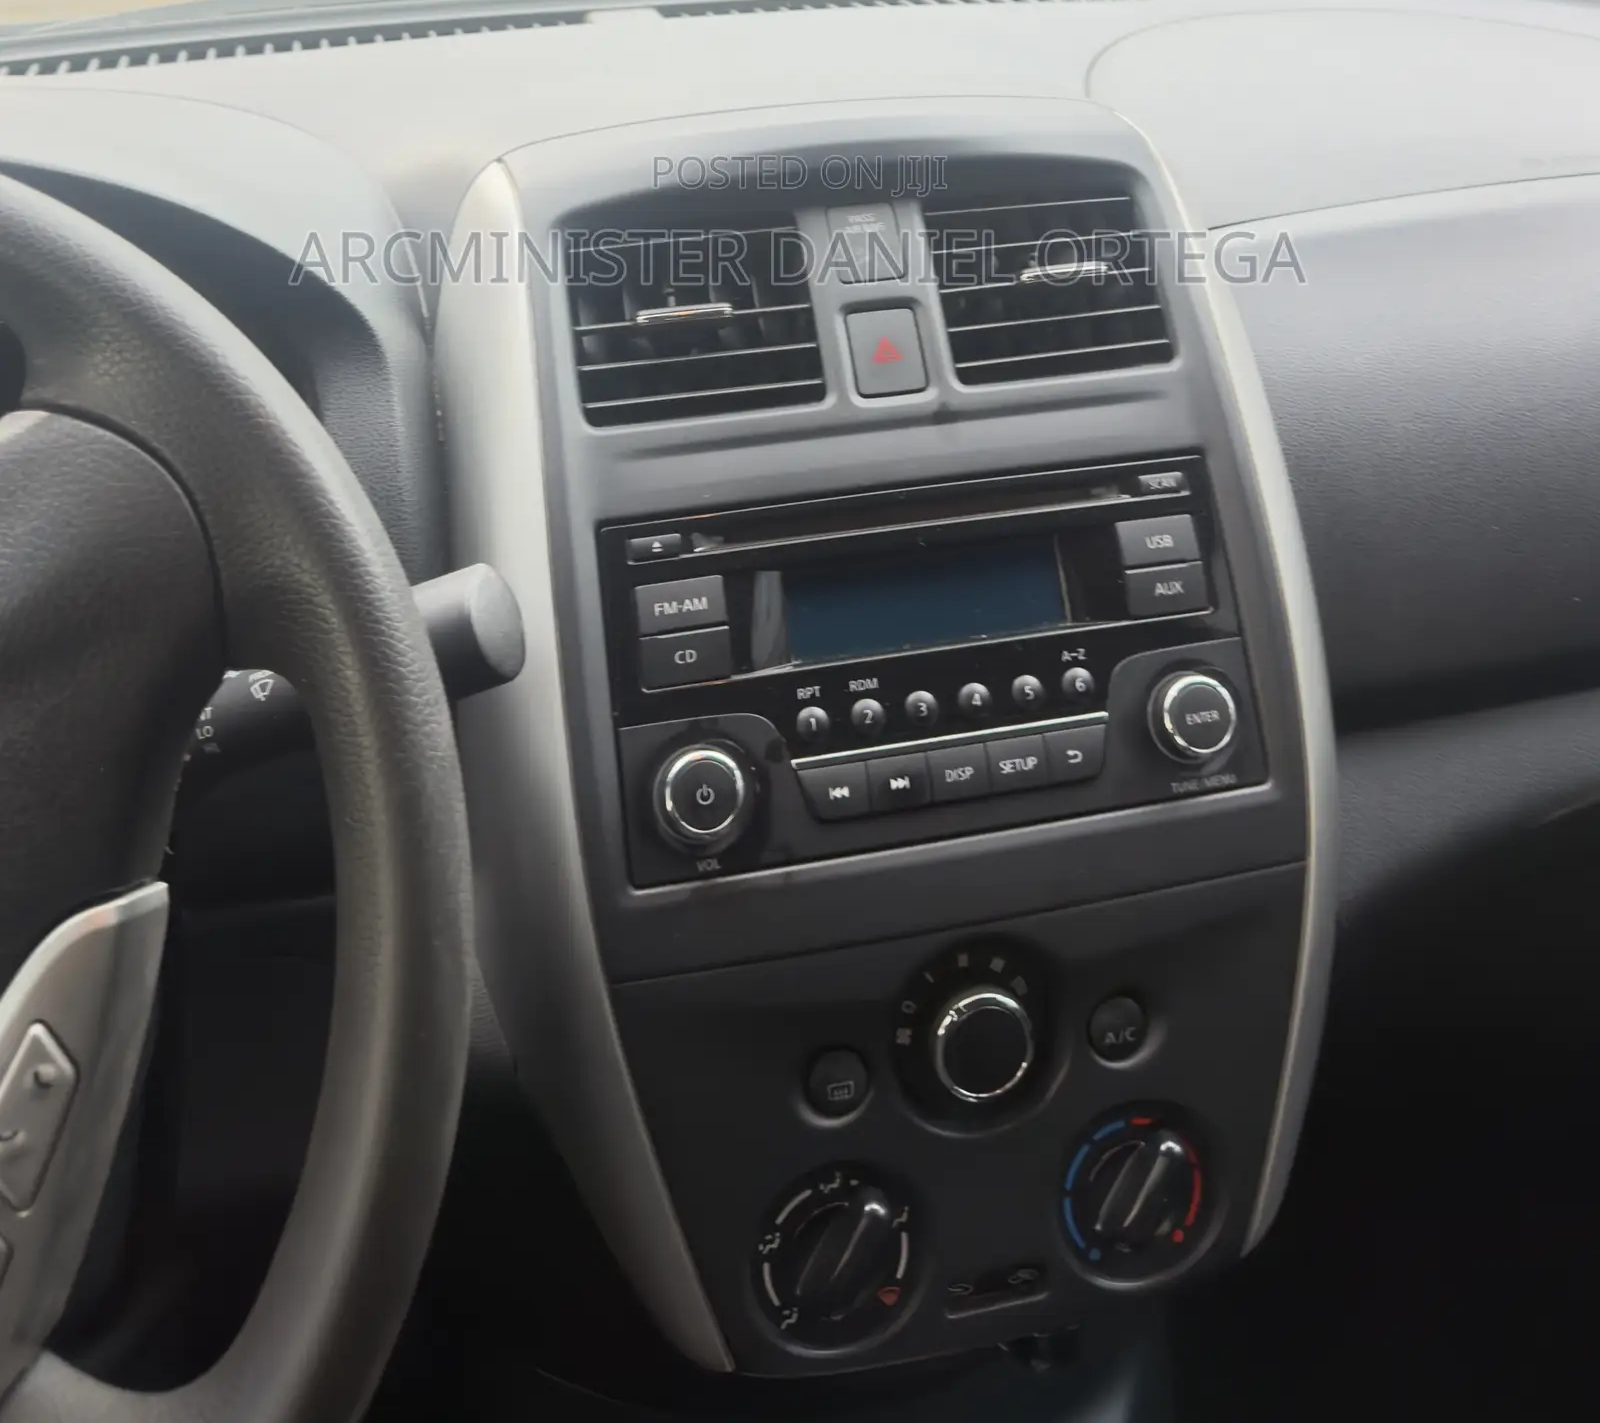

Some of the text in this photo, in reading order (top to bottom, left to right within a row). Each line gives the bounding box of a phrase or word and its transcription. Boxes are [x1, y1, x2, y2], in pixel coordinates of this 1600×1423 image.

[1145, 534, 1173, 549] USB
[1154, 581, 1185, 596] AUX
[653, 596, 709, 617] FM-AM
[674, 648, 698, 665] CD
[1061, 648, 1086, 663] A-Z
[849, 677, 879, 692] RDM
[1075, 677, 1086, 692] 6
[797, 685, 821, 700] RPT
[971, 692, 981, 707] 4
[1024, 685, 1034, 700] 5
[863, 709, 874, 725] 2
[917, 703, 928, 717] 3
[1186, 709, 1220, 725] ENTER
[196, 725, 214, 739] LO
[809, 717, 818, 732] 1
[999, 756, 1038, 774] SETUP
[945, 766, 974, 781] DISP
[696, 858, 722, 872] VOL
[1105, 1027, 1137, 1044] A/C
